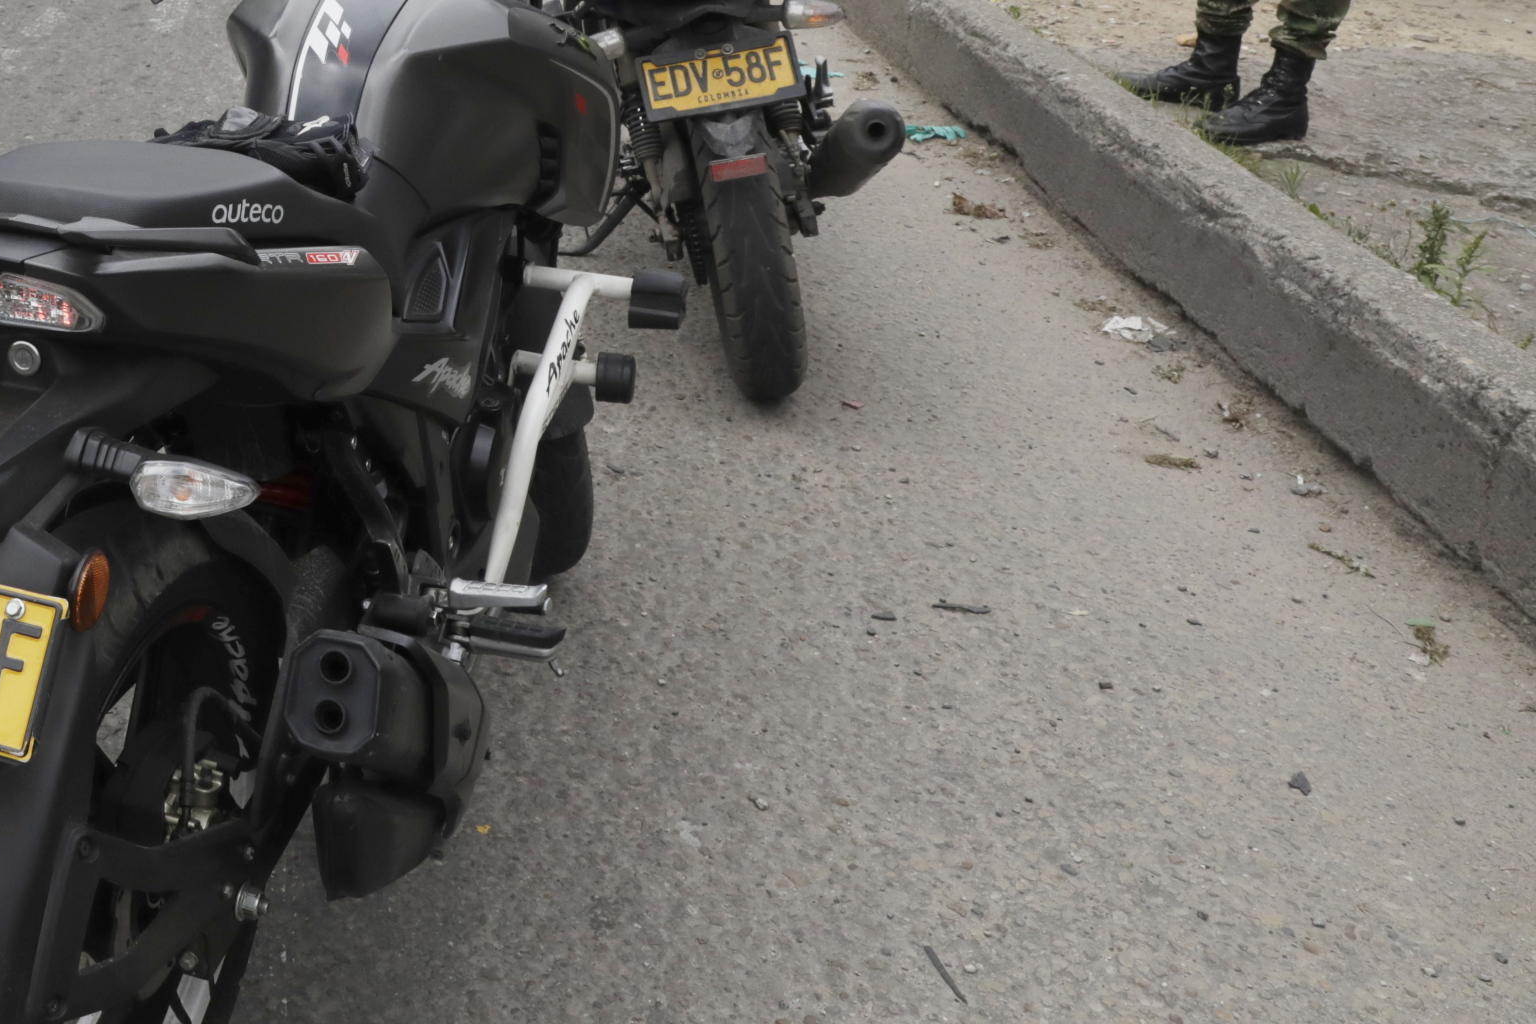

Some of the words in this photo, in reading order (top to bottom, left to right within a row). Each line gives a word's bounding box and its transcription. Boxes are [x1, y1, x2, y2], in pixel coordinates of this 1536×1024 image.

[647, 61, 709, 102] EDV
[722, 46, 783, 87] 58F
[697, 88, 752, 104] COLOMBIA
[212, 199, 284, 224] auteco
[546, 309, 579, 398] Apache
